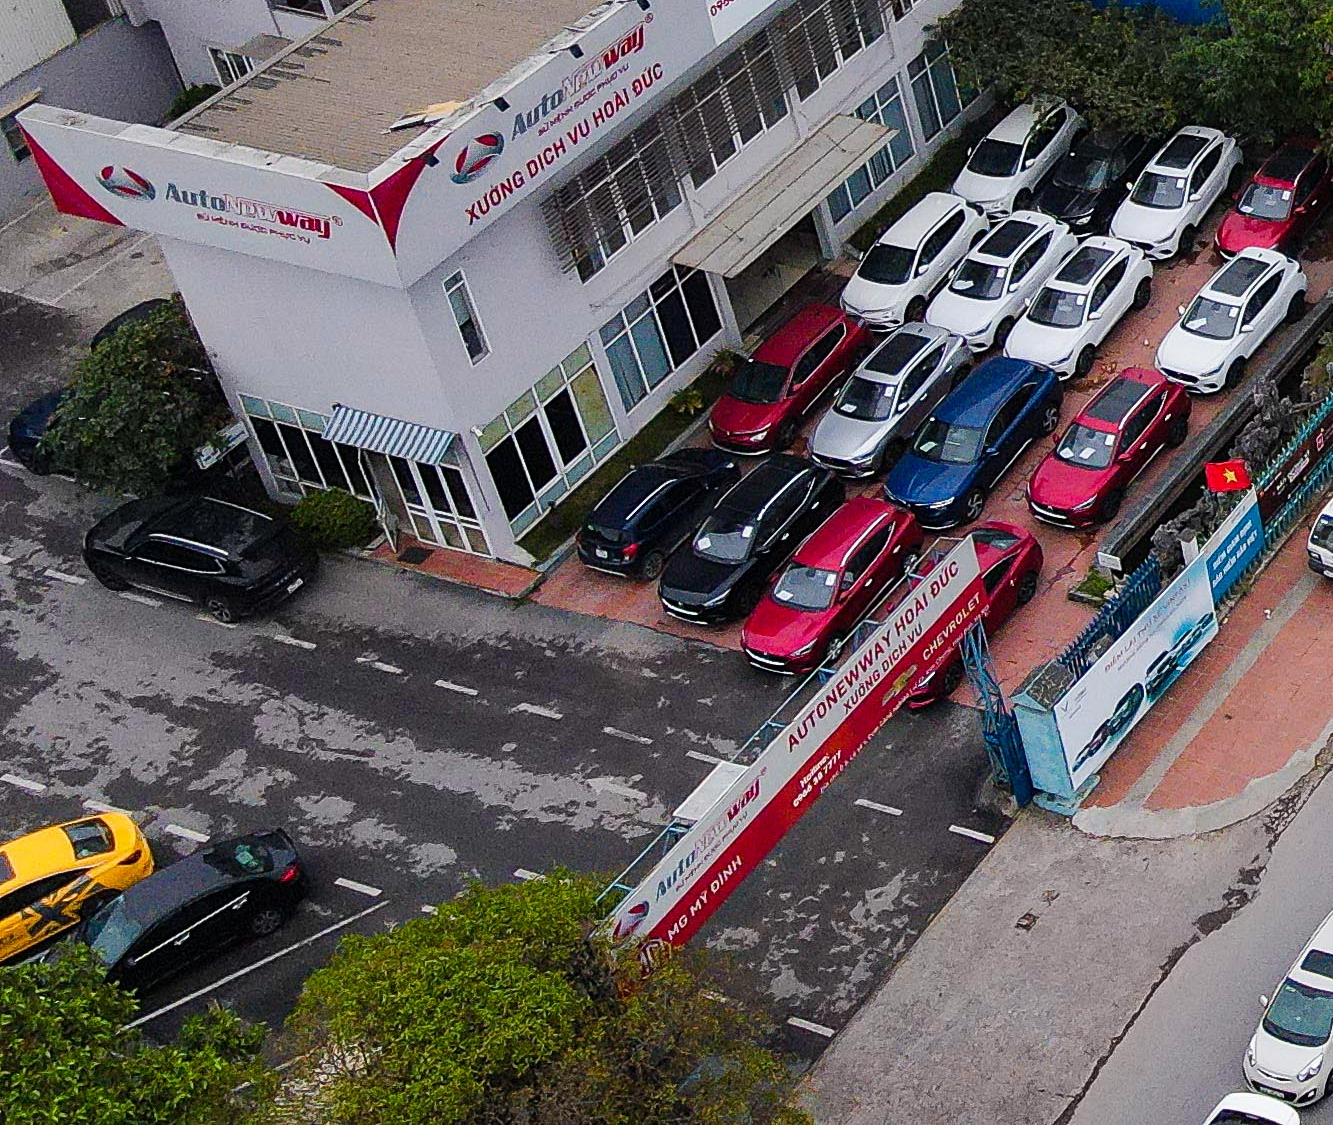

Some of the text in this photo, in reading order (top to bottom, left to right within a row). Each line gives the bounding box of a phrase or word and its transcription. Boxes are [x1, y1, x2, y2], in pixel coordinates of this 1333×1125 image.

[566, 119, 590, 146] VỤ
[592, 88, 630, 127] HOÀI
[631, 63, 664, 97] ĐỨC
[788, 561, 959, 752] AUTONEWWAY HOÀI ĐỨC
[922, 592, 981, 661] CHEVROLET
[667, 918, 688, 941] MG
